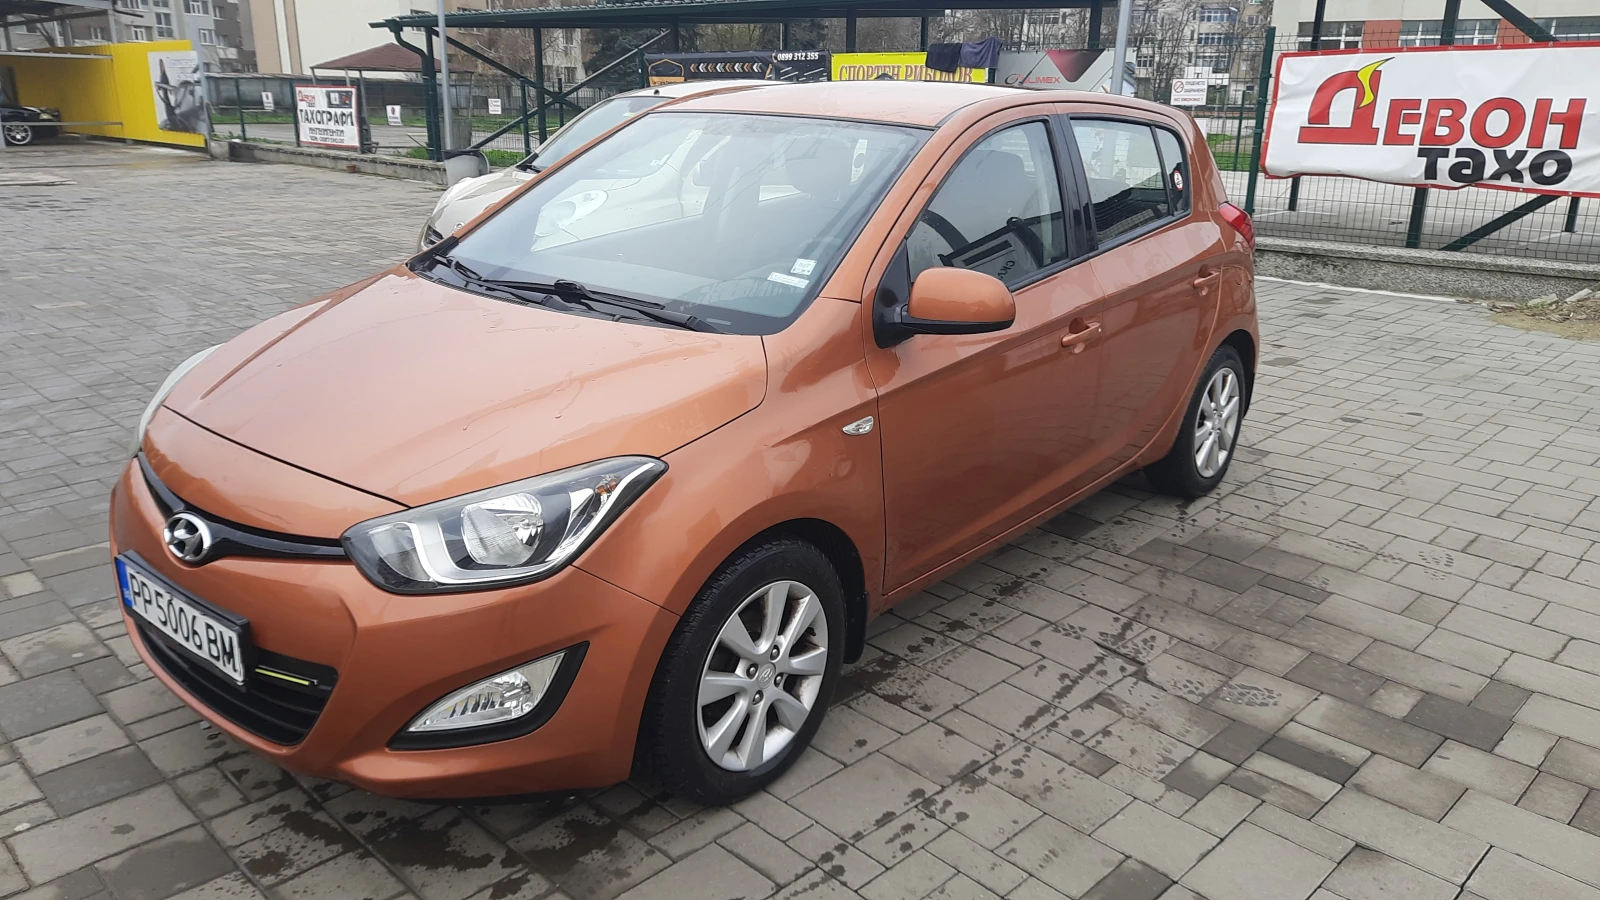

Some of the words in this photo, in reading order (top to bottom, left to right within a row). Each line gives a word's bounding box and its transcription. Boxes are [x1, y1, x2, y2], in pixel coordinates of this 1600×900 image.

[777, 52, 793, 61] 0899
[794, 52, 805, 61] 312
[806, 52, 819, 61] 355
[1297, 68, 1586, 149] ДЕВОН
[129, 573, 152, 614] PP
[154, 589, 203, 651] 5006
[205, 621, 238, 673] BM
